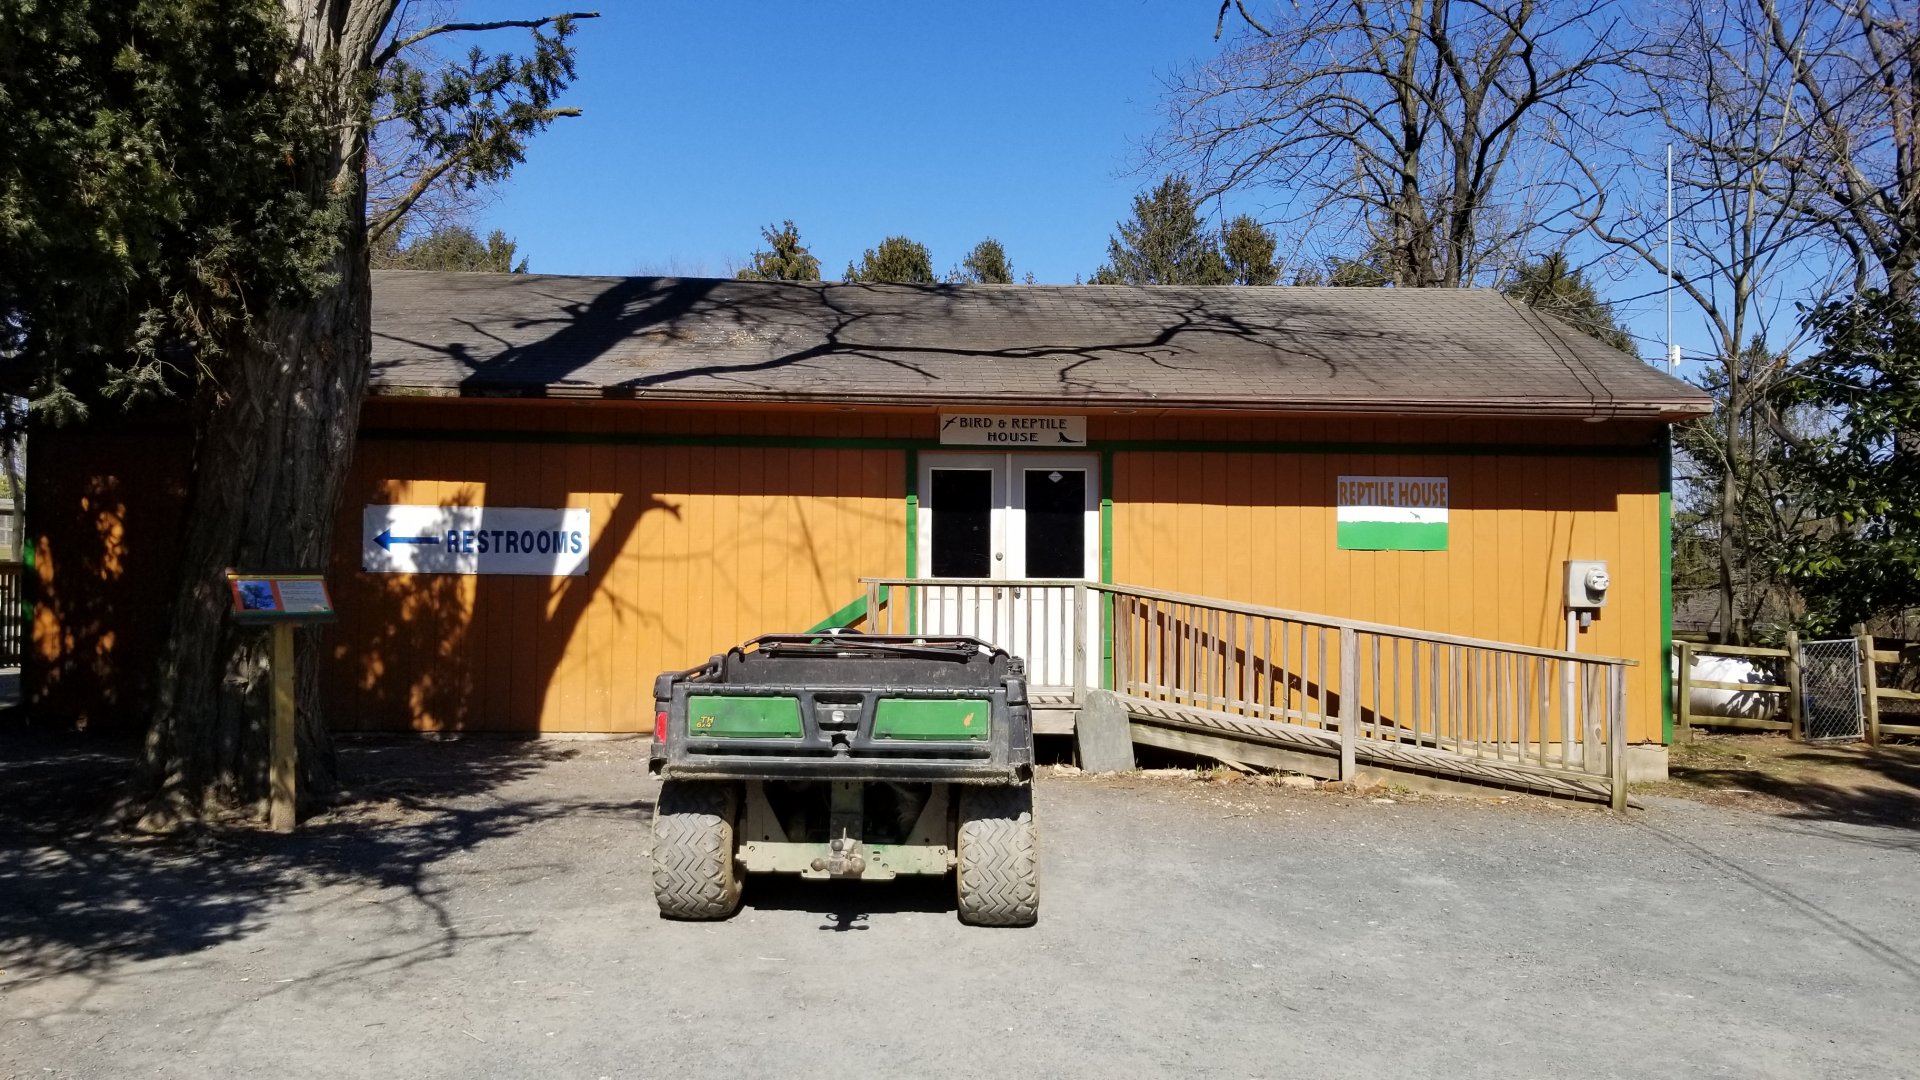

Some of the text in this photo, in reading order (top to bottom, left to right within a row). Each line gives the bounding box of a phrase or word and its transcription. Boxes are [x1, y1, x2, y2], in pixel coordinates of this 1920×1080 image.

[959, 417, 1068, 429] BIRD & REPTILE
[987, 432, 1039, 442] HOUSE
[1340, 481, 1446, 507] REPTILE HOUSE
[447, 529, 583, 554] RESTROOMS
[701, 716, 715, 724] TH
